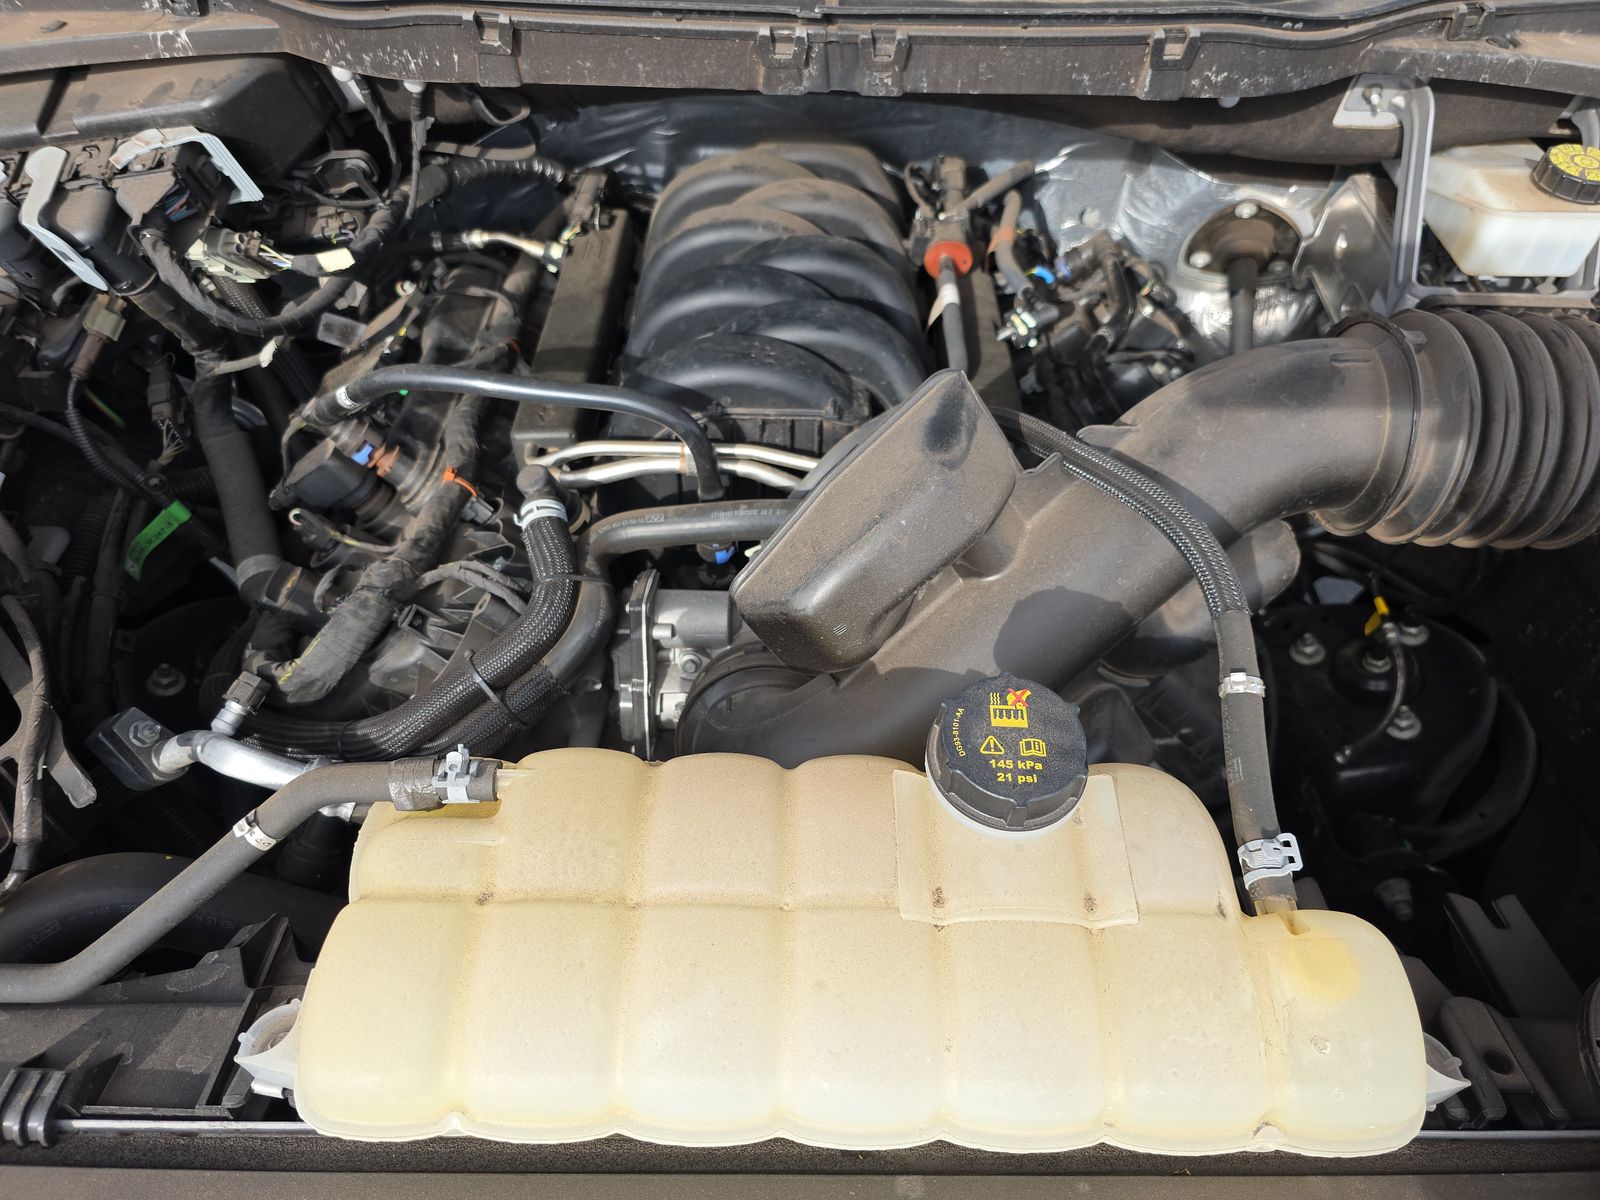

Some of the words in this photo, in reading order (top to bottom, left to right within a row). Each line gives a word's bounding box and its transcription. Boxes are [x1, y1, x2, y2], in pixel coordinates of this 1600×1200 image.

[952, 707, 966, 757] DG93-8101-AA
[989, 758, 1014, 769] 145
[1017, 760, 1043, 770] kPa
[996, 772, 1013, 782] 21
[1017, 773, 1038, 784] psi
